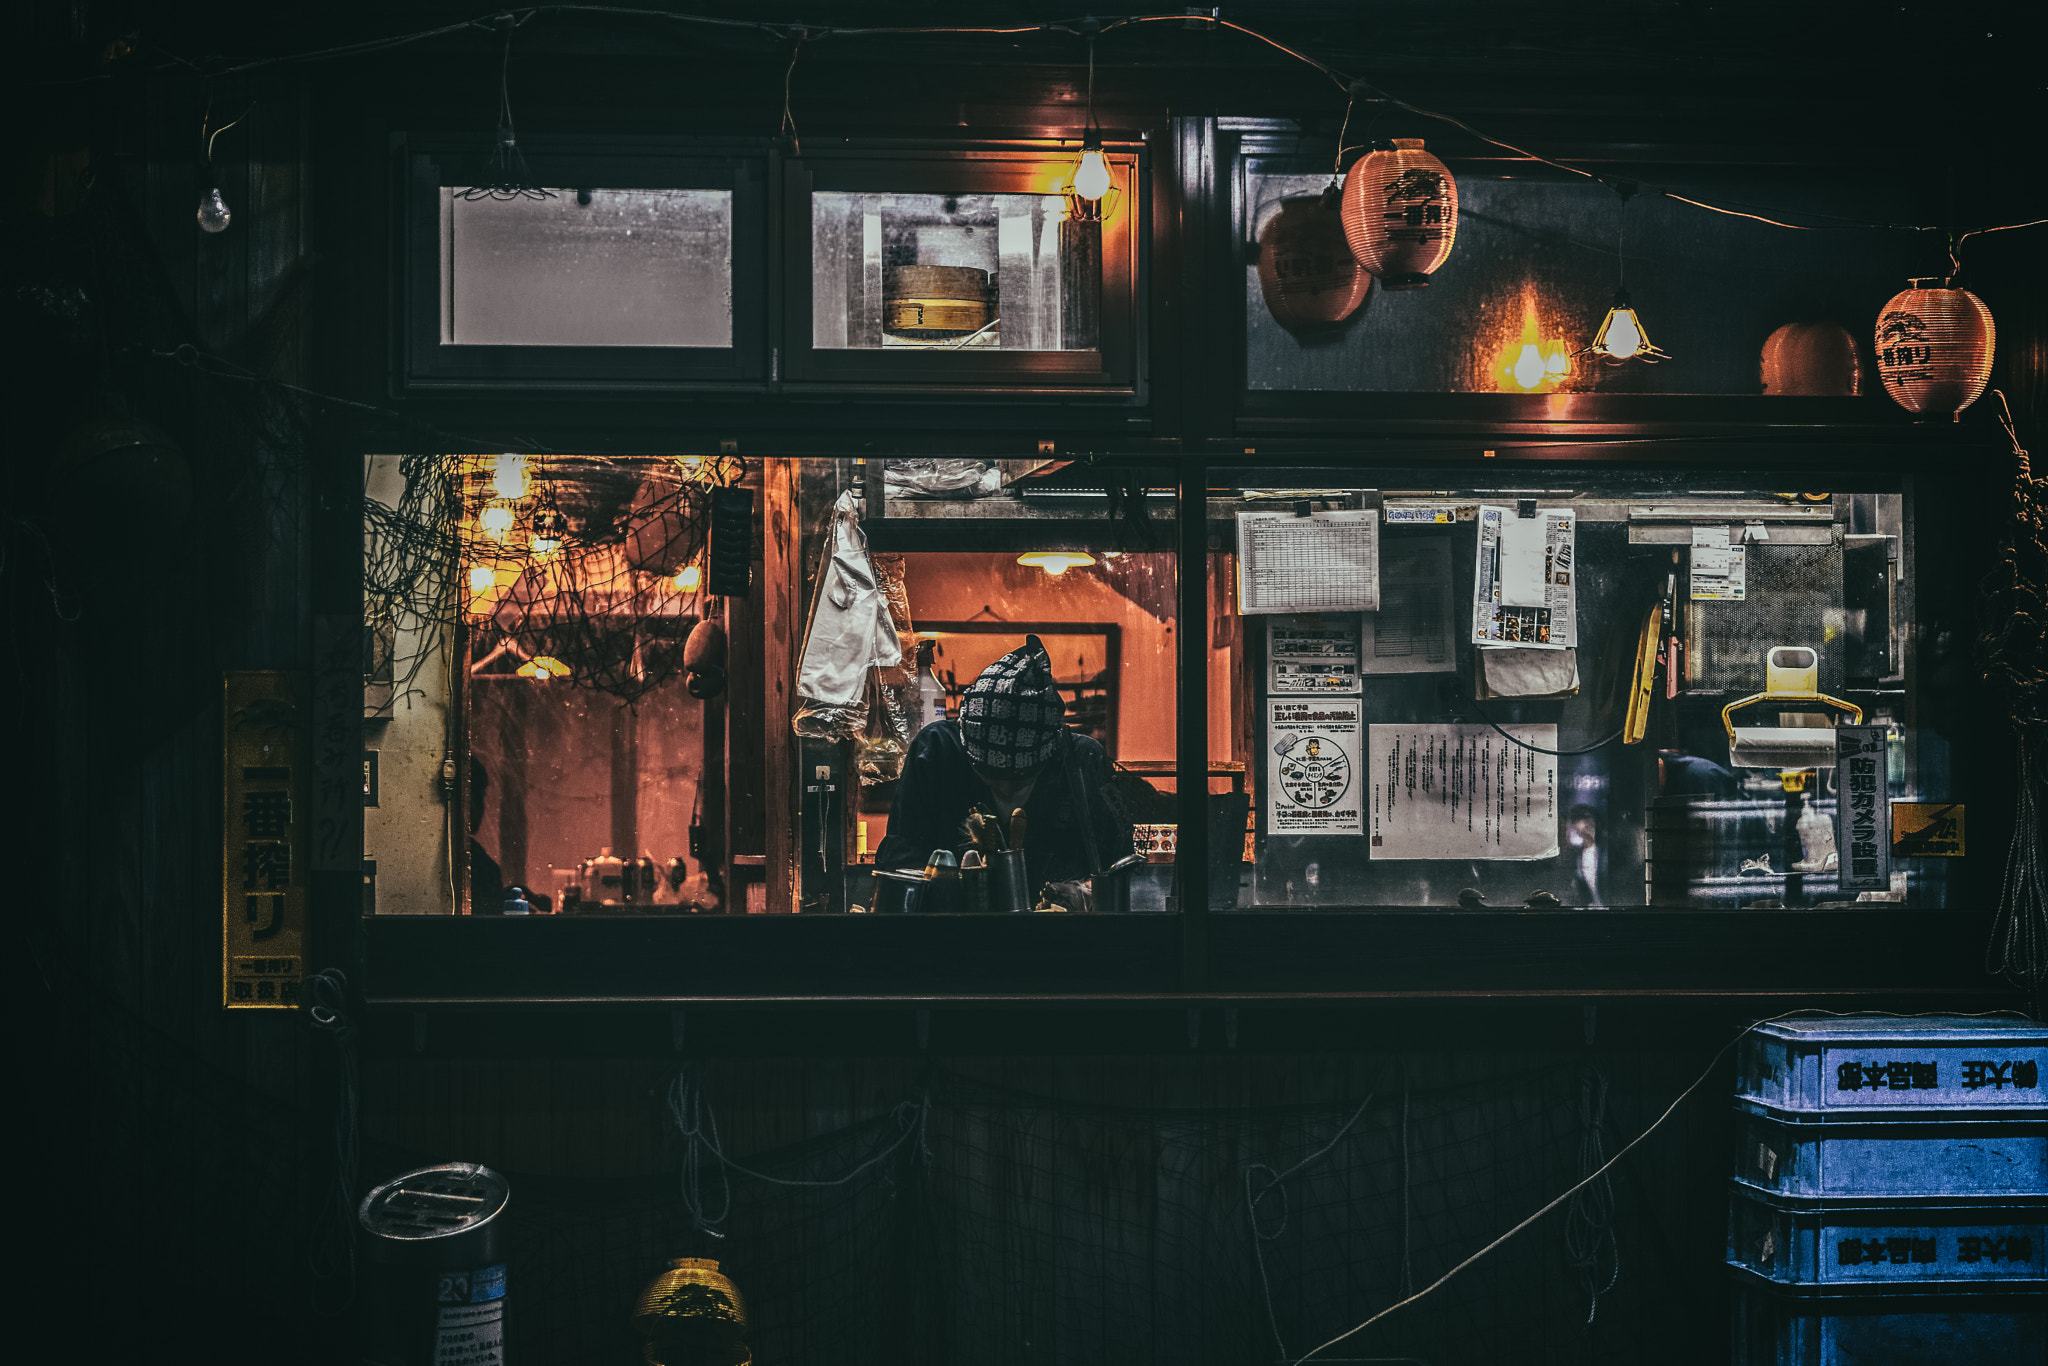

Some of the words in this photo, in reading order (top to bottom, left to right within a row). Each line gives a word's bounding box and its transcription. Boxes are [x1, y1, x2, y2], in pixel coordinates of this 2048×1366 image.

[1849, 757, 1879, 878] 防犯カメラ設置
[242, 766, 292, 941] 一番搾り
[233, 981, 299, 1000] 取扱店
[1837, 1060, 1938, 1091] 商品本部
[1838, 1236, 1937, 1266] 商品本部
